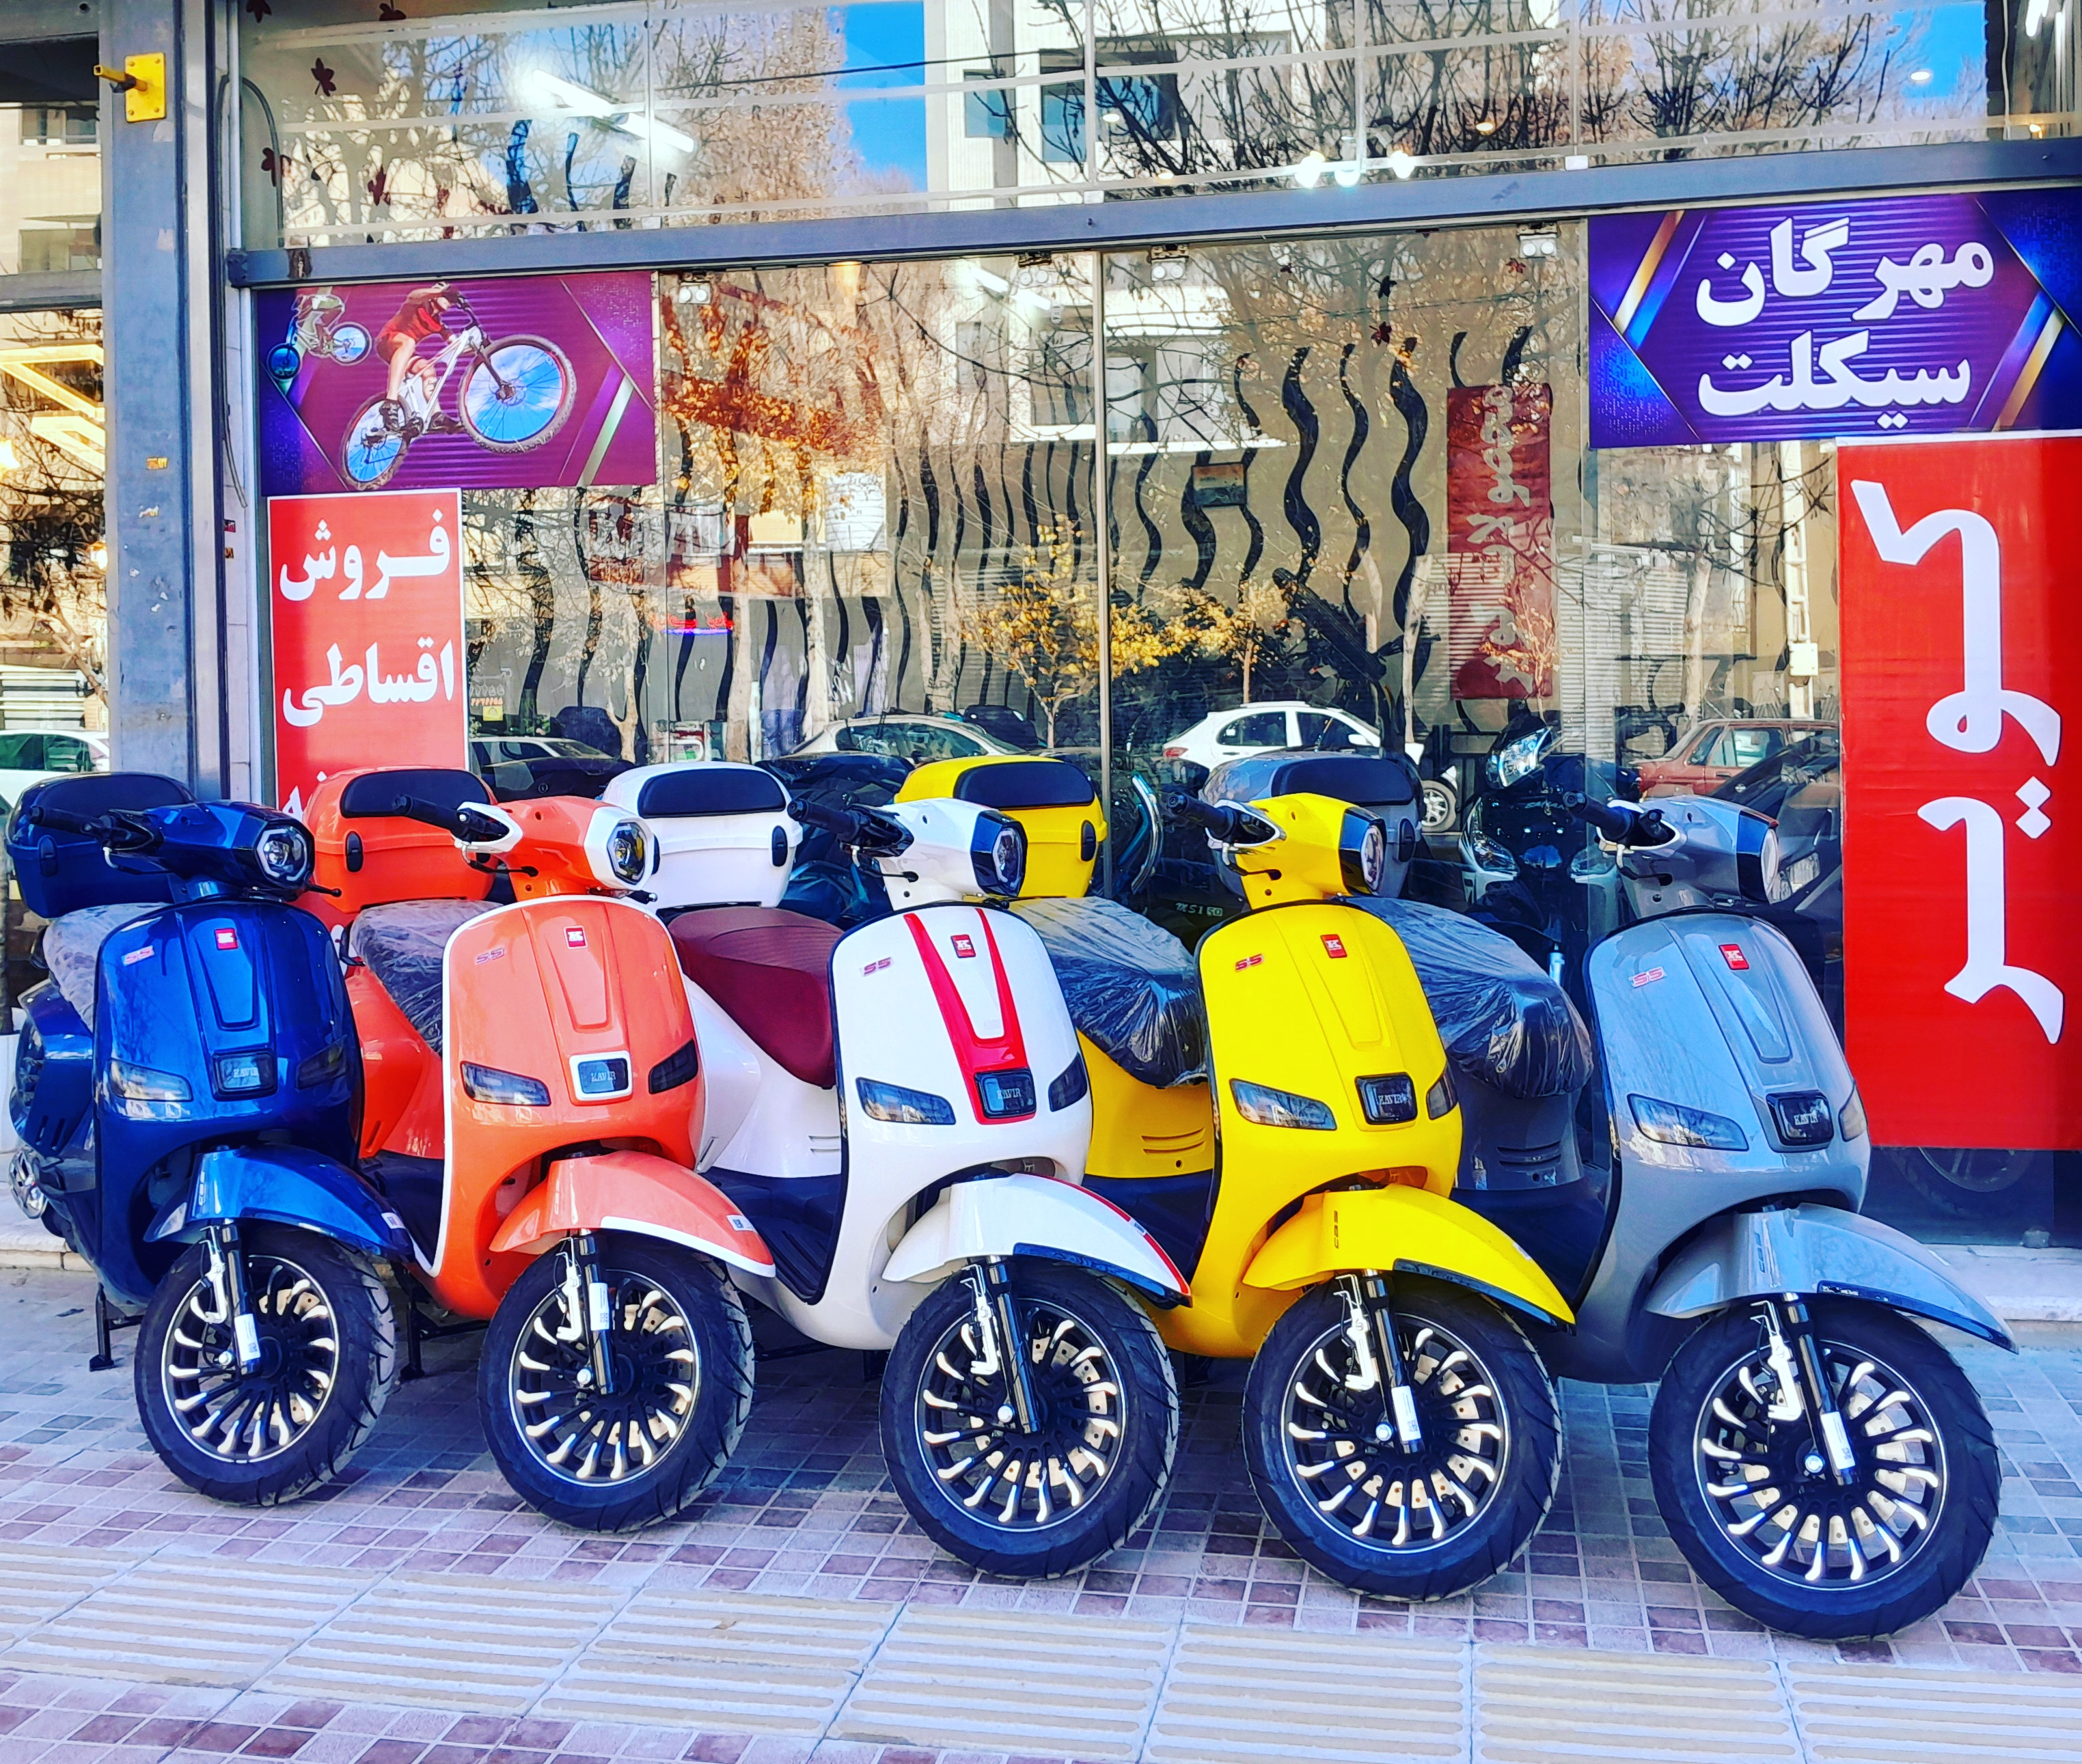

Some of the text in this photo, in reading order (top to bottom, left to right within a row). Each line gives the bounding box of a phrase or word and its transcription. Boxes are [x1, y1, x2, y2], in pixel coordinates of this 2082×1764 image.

[1698, 329, 1971, 429] سیکلت
[279, 508, 450, 601] فروش
[283, 635, 454, 727] اقساطی
[1850, 479, 2064, 1044] کویر
[590, 1071, 616, 1082] KAVIR
[996, 1088, 1022, 1100] KAVIR
[1378, 1094, 1403, 1105] KAVIR
